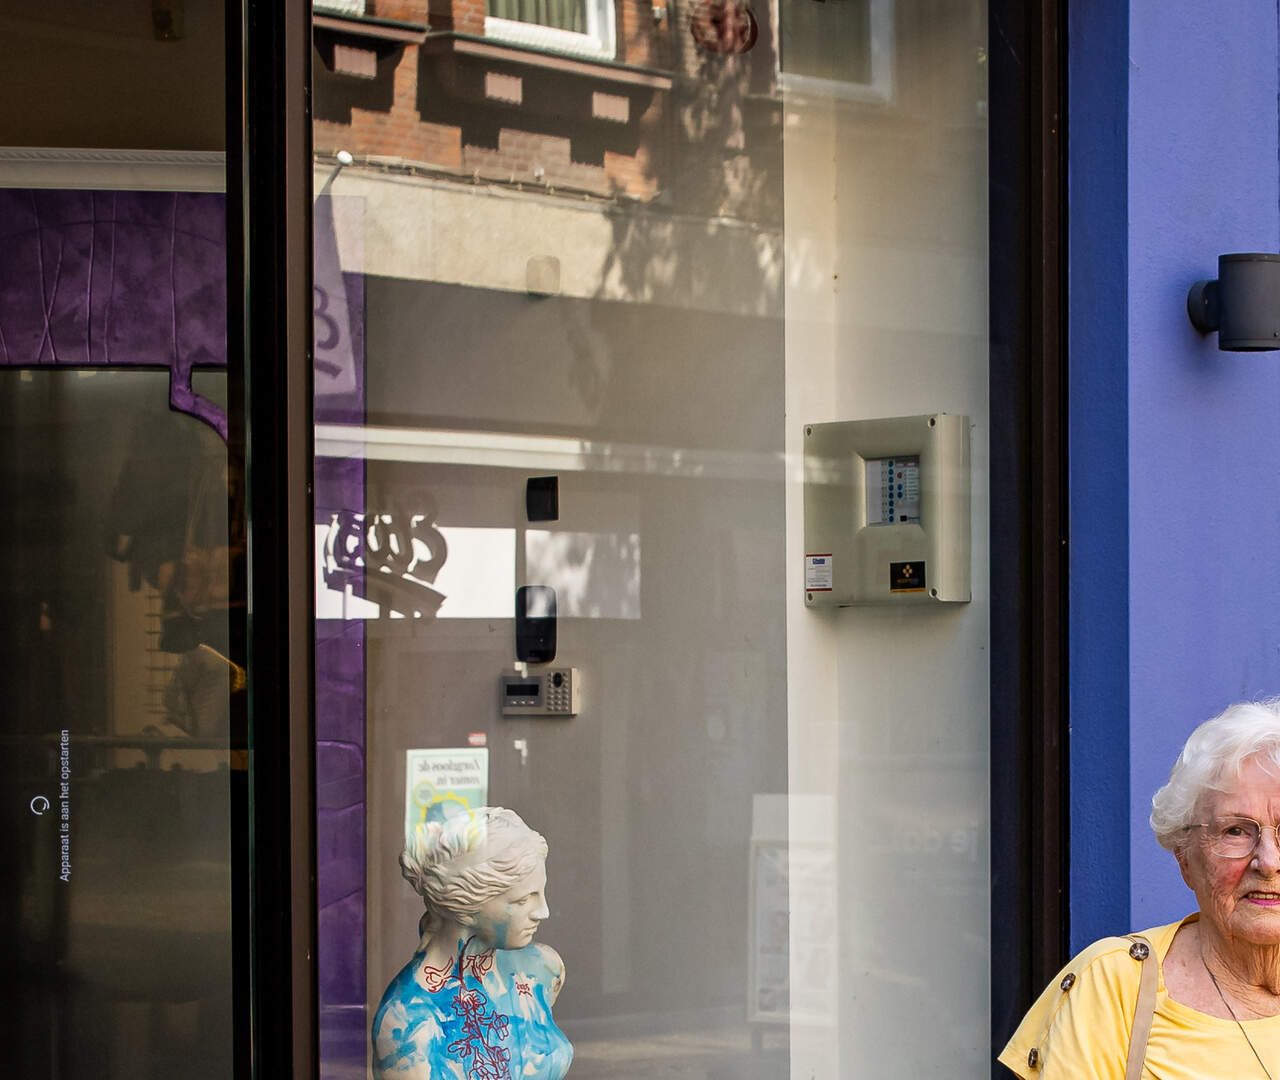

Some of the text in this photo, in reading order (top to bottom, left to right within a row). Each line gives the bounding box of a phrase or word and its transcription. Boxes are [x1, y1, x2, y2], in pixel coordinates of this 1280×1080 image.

[59, 729, 71, 882] Apparaat is aan het opstarten
